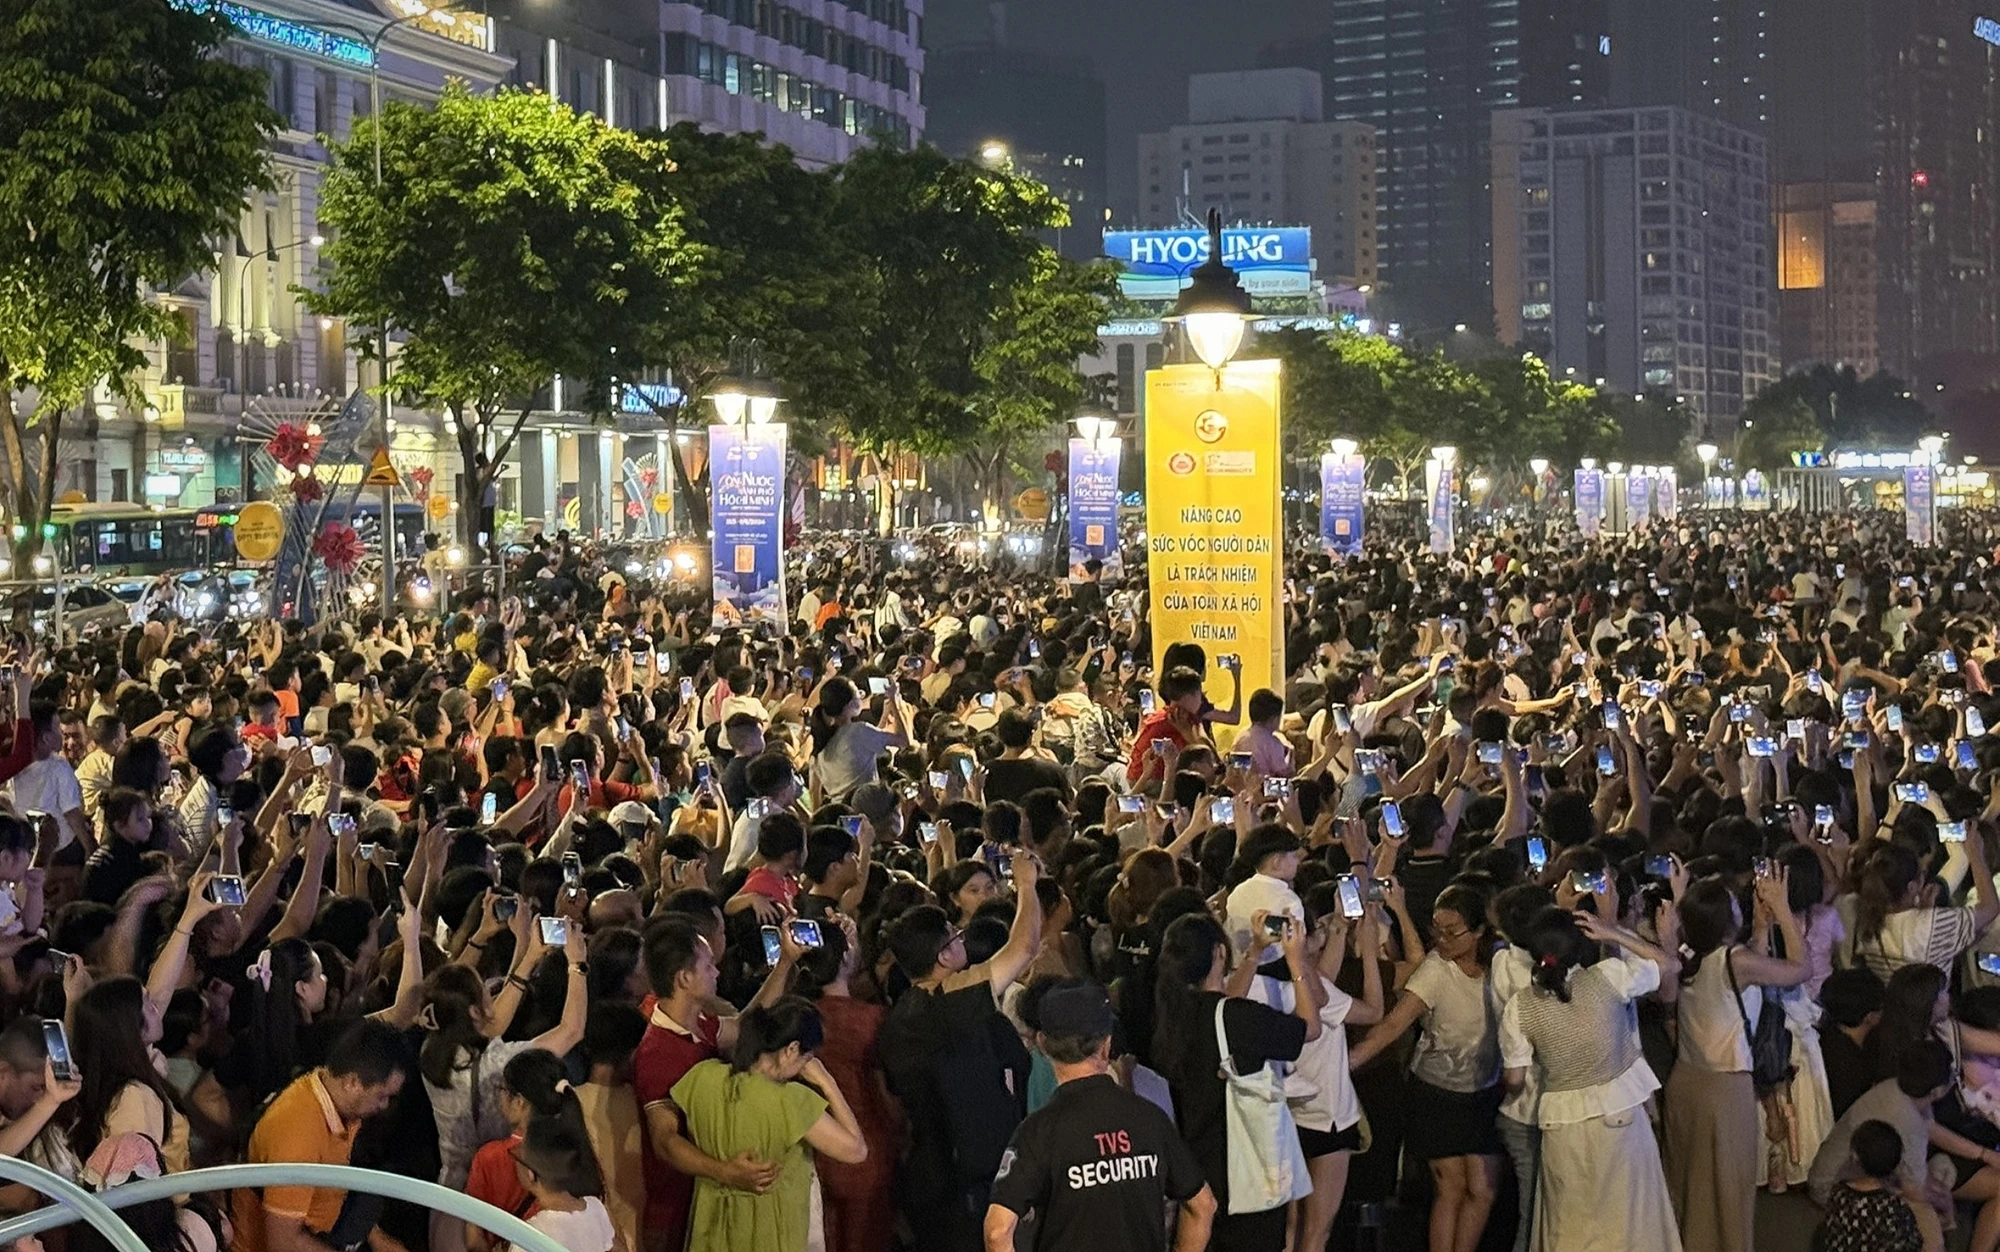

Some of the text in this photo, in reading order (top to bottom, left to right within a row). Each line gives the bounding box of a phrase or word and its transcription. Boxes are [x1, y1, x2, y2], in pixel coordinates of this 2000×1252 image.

[1215, 508, 1241, 523] CAO
[1152, 533, 1175, 552] SỨC
[1179, 534, 1205, 552] VÓC
[1208, 534, 1243, 553] NGƯỜI
[1167, 562, 1257, 586] LÀ TRÁCH NHIỆM
[1164, 590, 1261, 615] CỦA TOÀN XÃ HỘI
[1191, 621, 1237, 642] VIỆT NAM
[1094, 1129, 1131, 1156] TVS
[1068, 1154, 1158, 1189] SECURITY
